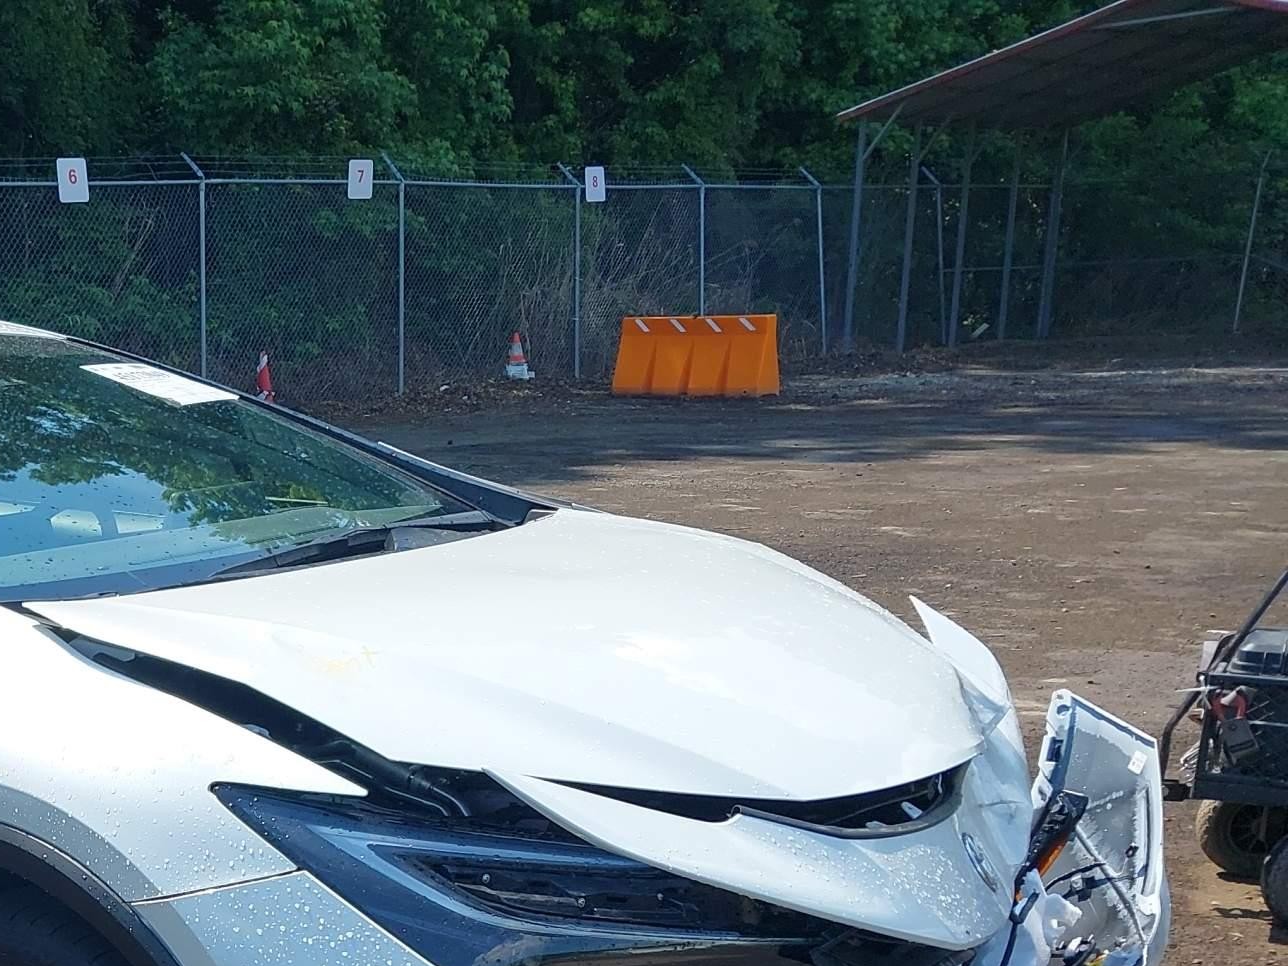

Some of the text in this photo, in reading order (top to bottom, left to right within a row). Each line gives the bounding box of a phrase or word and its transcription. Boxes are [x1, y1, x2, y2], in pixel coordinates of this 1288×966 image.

[68, 169, 78, 185] 6
[357, 170, 365, 183] 7
[592, 175, 599, 188] 8
